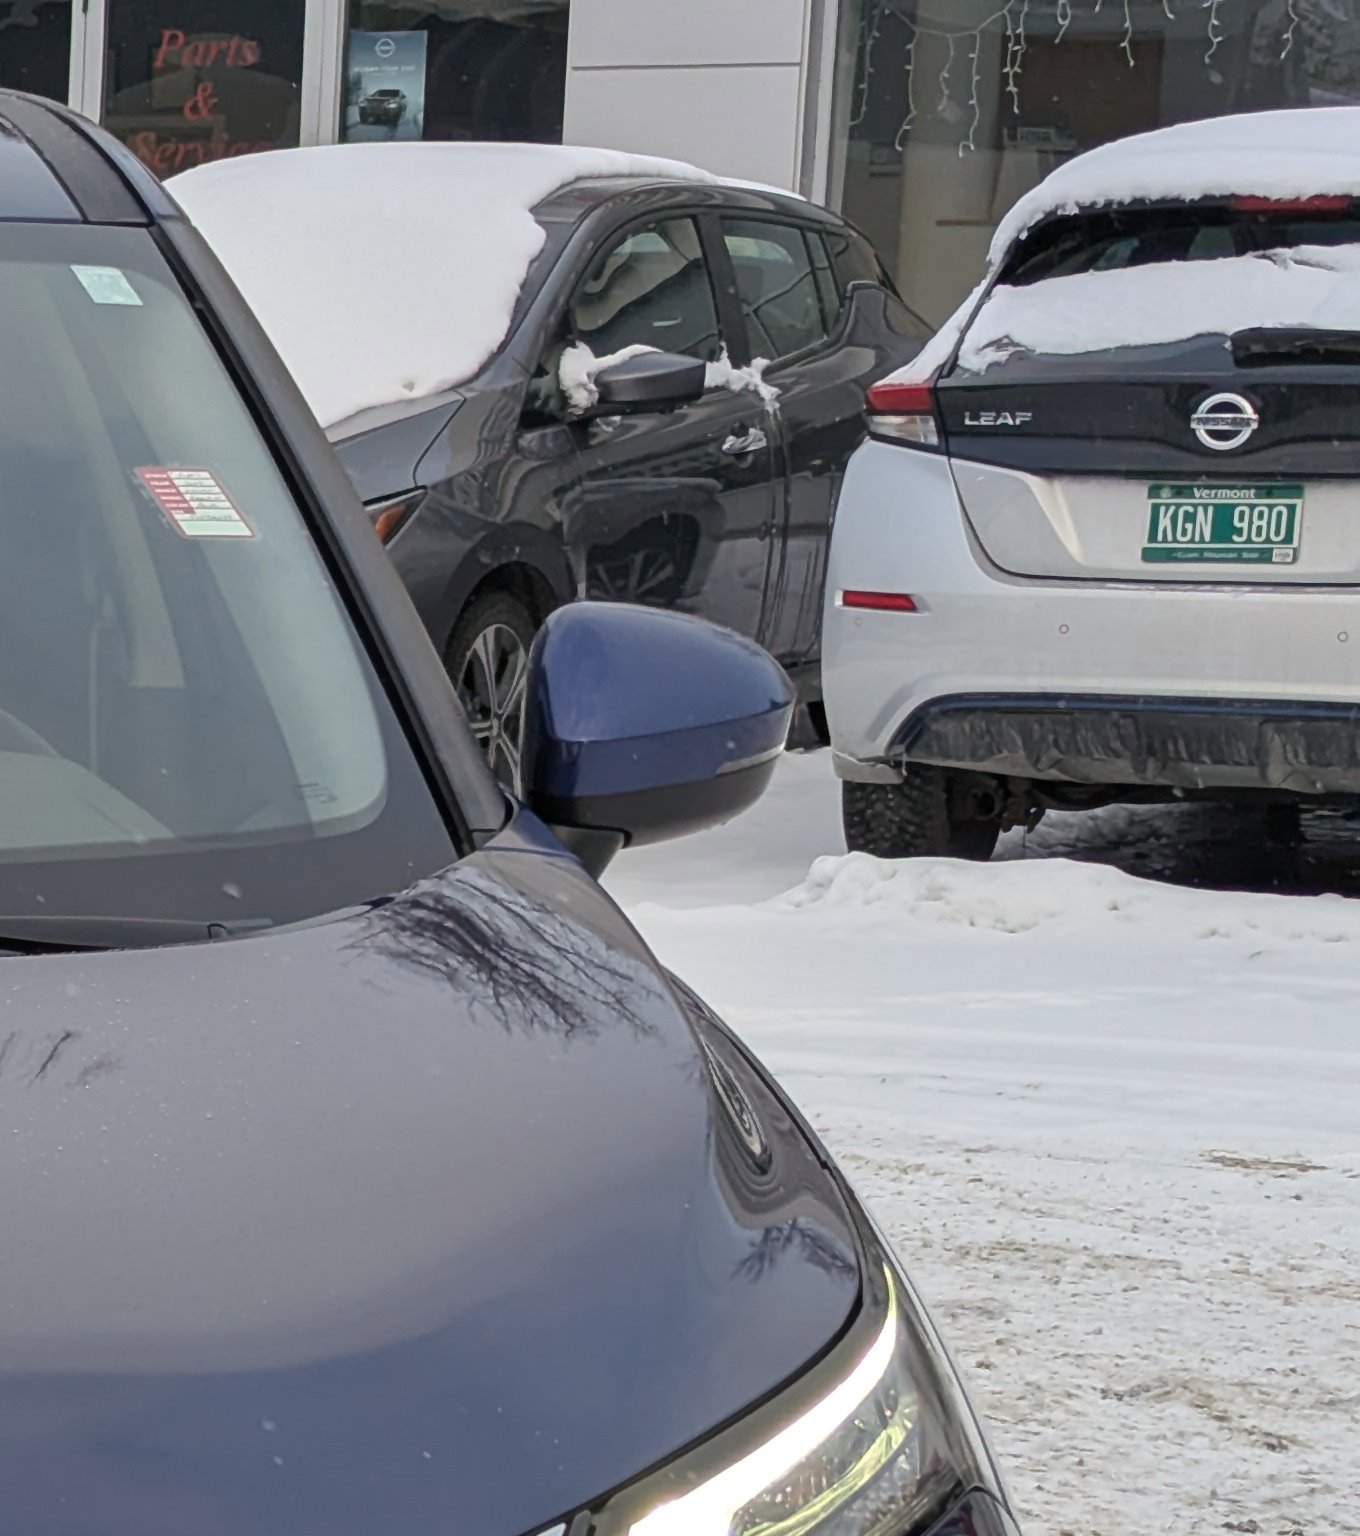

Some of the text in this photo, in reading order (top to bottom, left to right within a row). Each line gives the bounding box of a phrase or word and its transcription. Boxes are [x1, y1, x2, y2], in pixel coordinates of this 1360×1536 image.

[153, 29, 259, 67] Parts
[184, 80, 218, 121] &
[963, 411, 1033, 426] LEAF
[1192, 487, 1256, 499] Vermont
[1157, 505, 1288, 543] KGN 980
